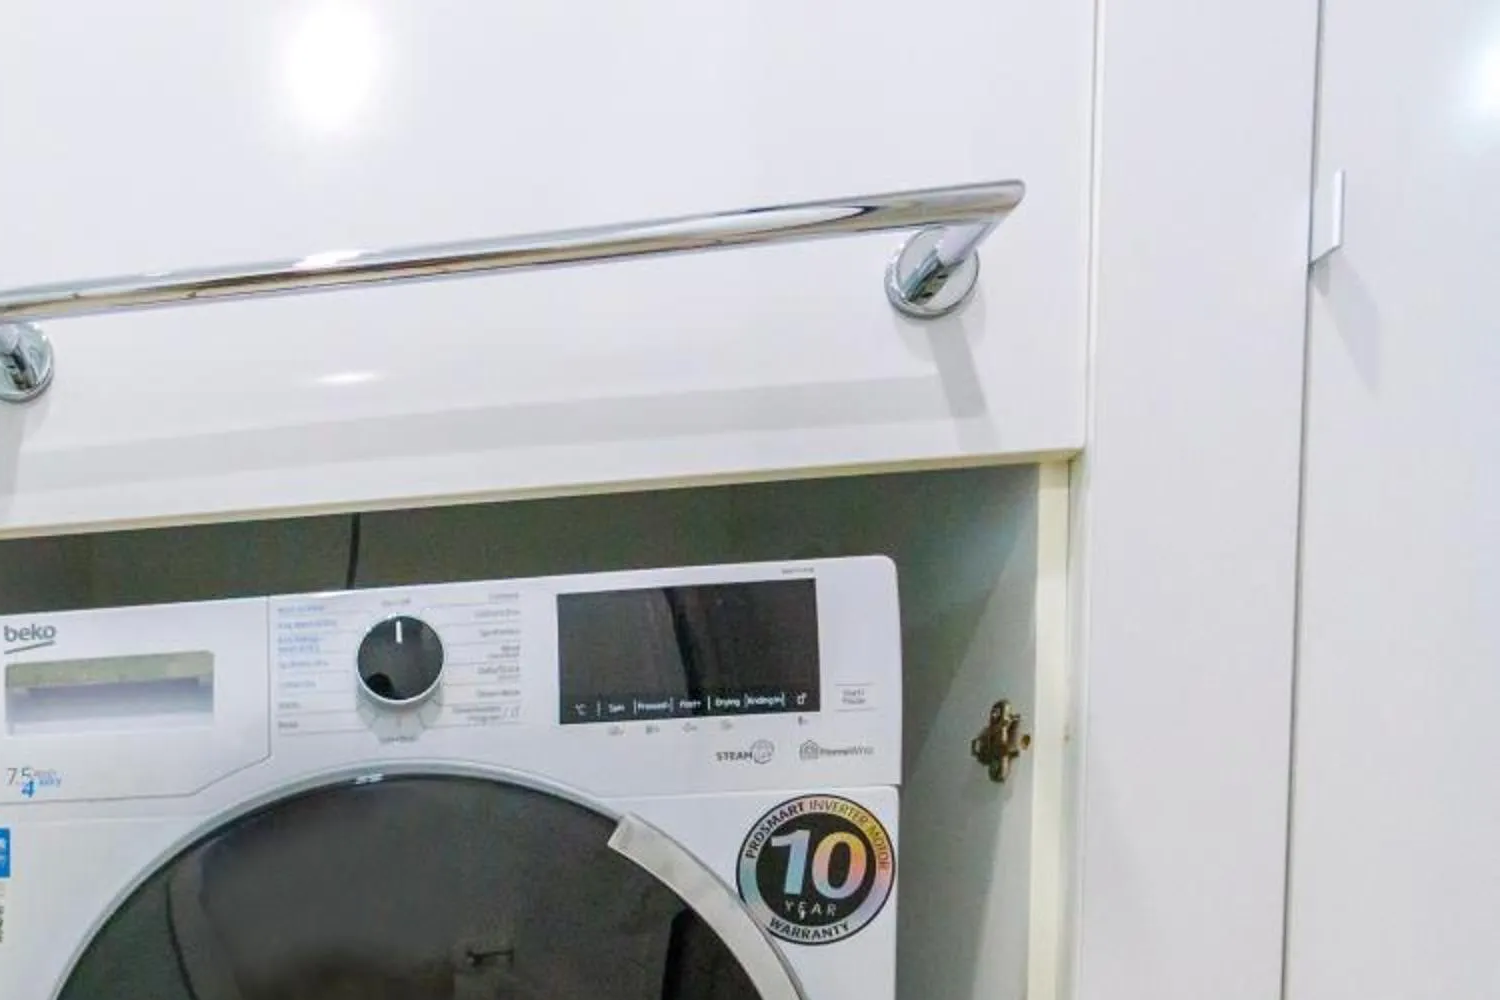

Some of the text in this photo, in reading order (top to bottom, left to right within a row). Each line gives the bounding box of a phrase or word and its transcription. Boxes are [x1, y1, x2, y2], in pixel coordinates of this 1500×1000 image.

[4, 623, 57, 642] beko
[716, 751, 753, 761] STEAM
[21, 779, 34, 798] 4
[745, 799, 890, 869] PROSMART INVERTER MOTOR
[771, 829, 867, 899] 10
[785, 900, 837, 916] YEAR
[769, 917, 850, 940] WARRANTY
